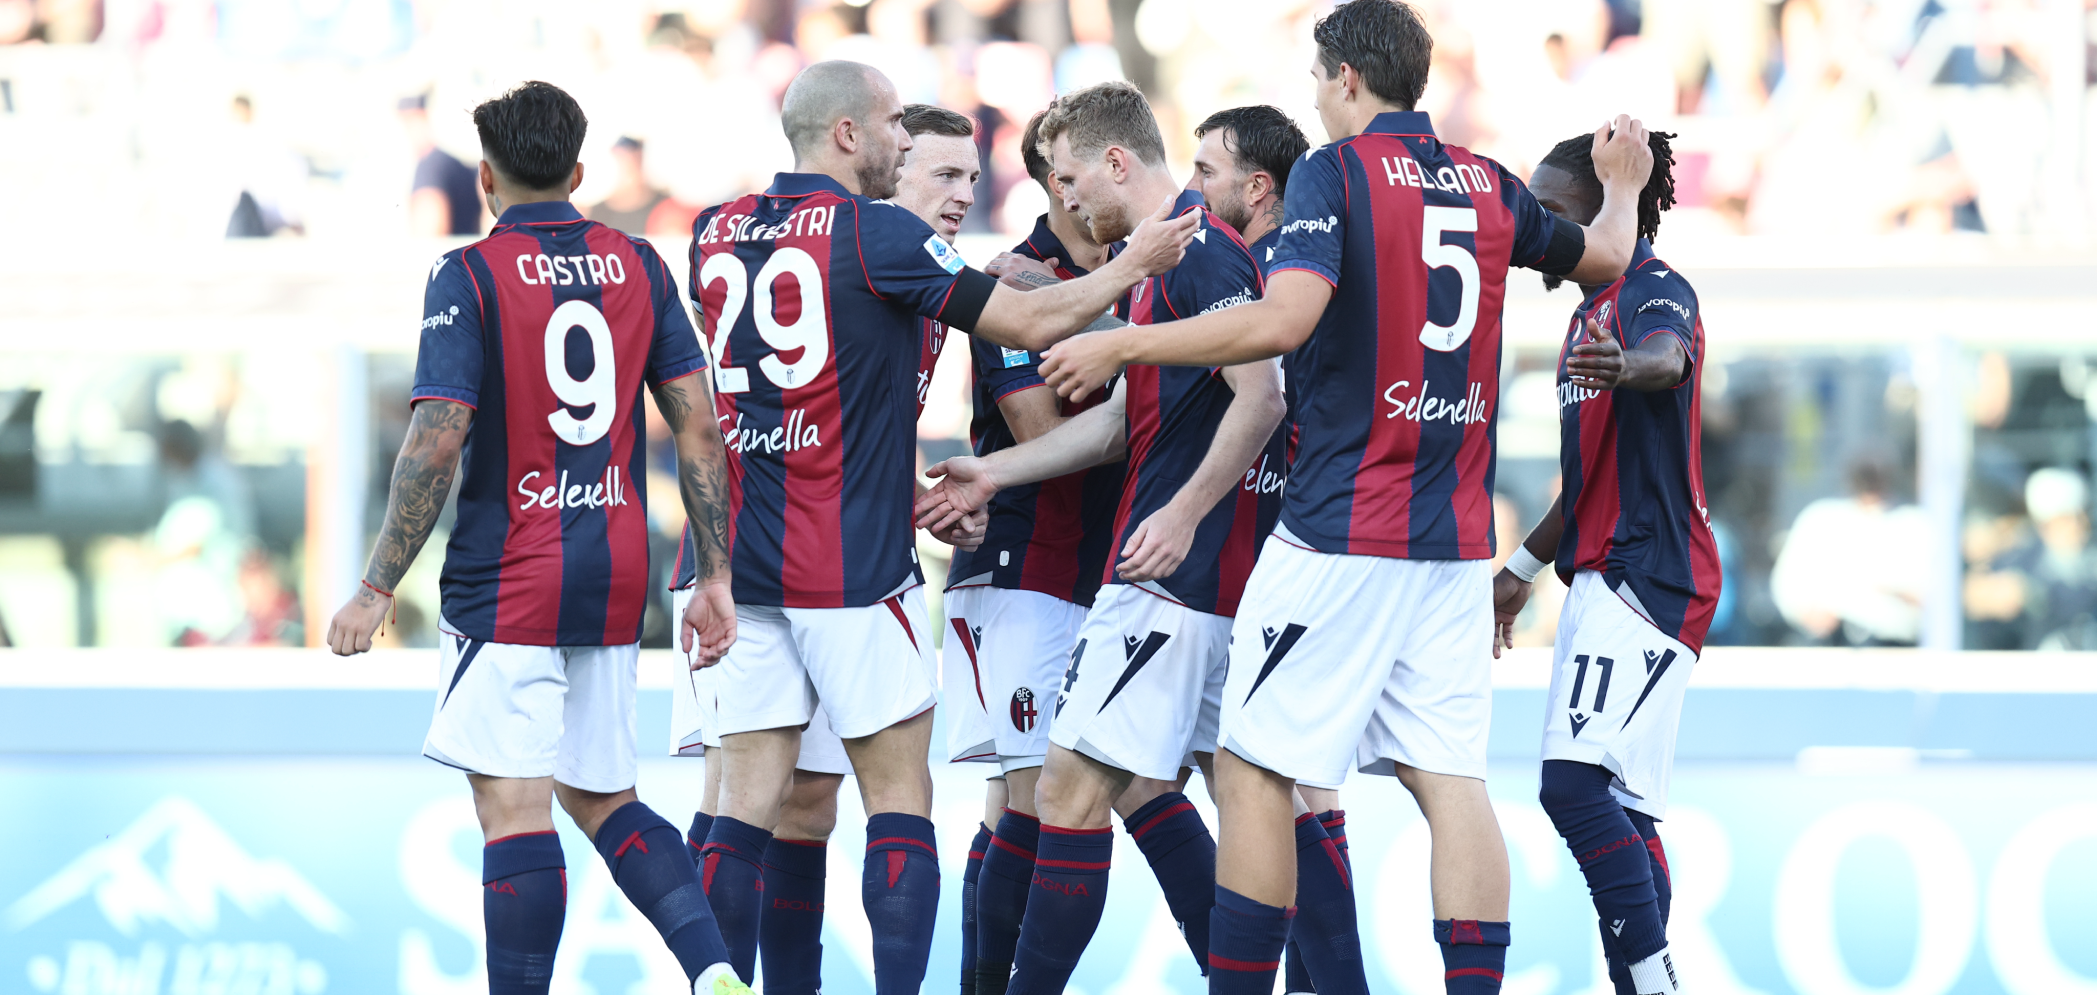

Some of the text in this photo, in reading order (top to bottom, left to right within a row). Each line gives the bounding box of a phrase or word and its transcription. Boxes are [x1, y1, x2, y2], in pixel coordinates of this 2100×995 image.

[1381, 156, 1493, 195] HELLAND
[698, 205, 836, 245] DE SILVESTRI
[516, 253, 627, 286] CASTRO
[1418, 205, 1480, 352] 5
[700, 247, 829, 393] 29
[544, 300, 616, 446] 9
[1383, 379, 1487, 425] Selenella
[1016, 688, 1030, 698] BFC
[1568, 654, 1614, 713] 11
